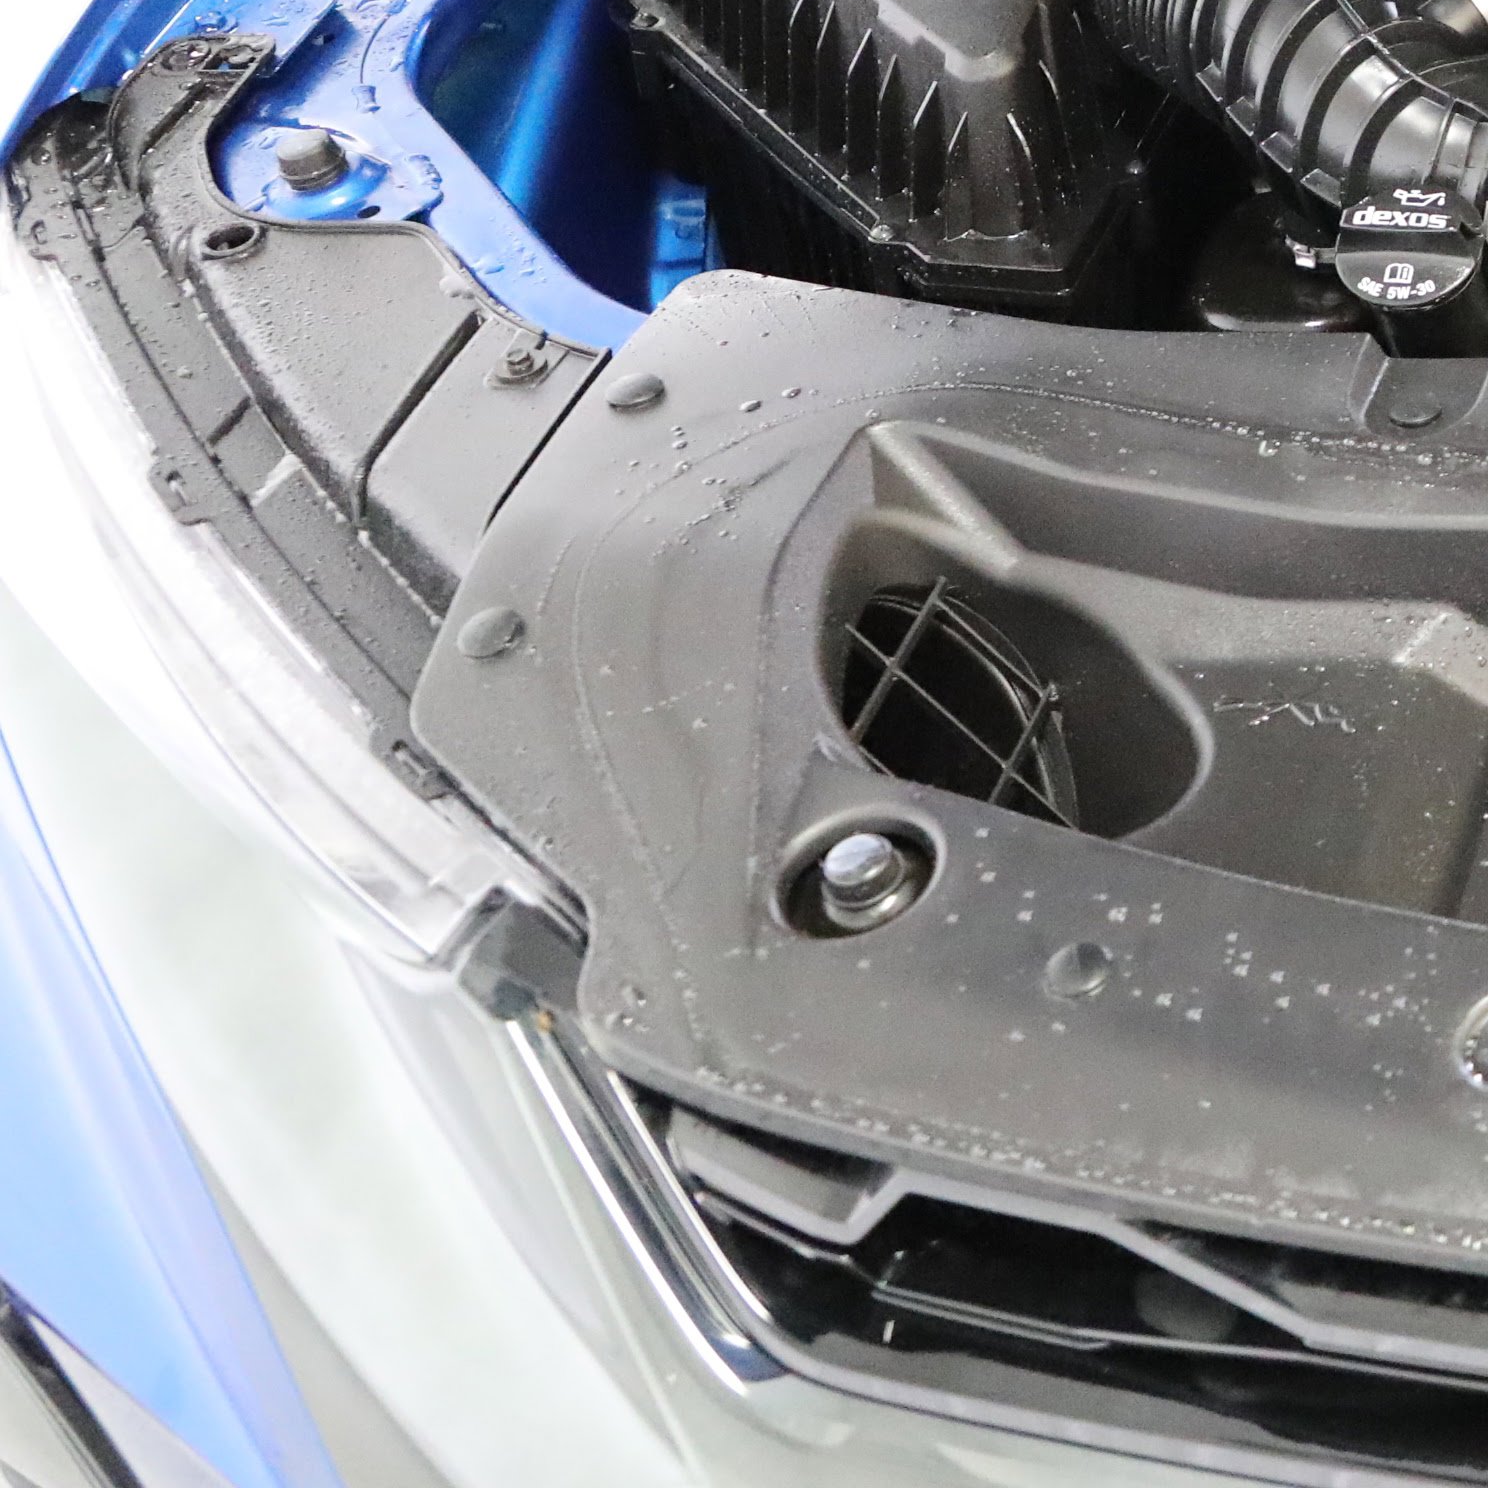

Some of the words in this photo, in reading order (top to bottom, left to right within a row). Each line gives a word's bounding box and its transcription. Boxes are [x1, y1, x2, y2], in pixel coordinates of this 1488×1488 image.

[1352, 205, 1452, 229] dexos
[1357, 276, 1385, 298] SAE
[1386, 279, 1436, 300] 5W-30
